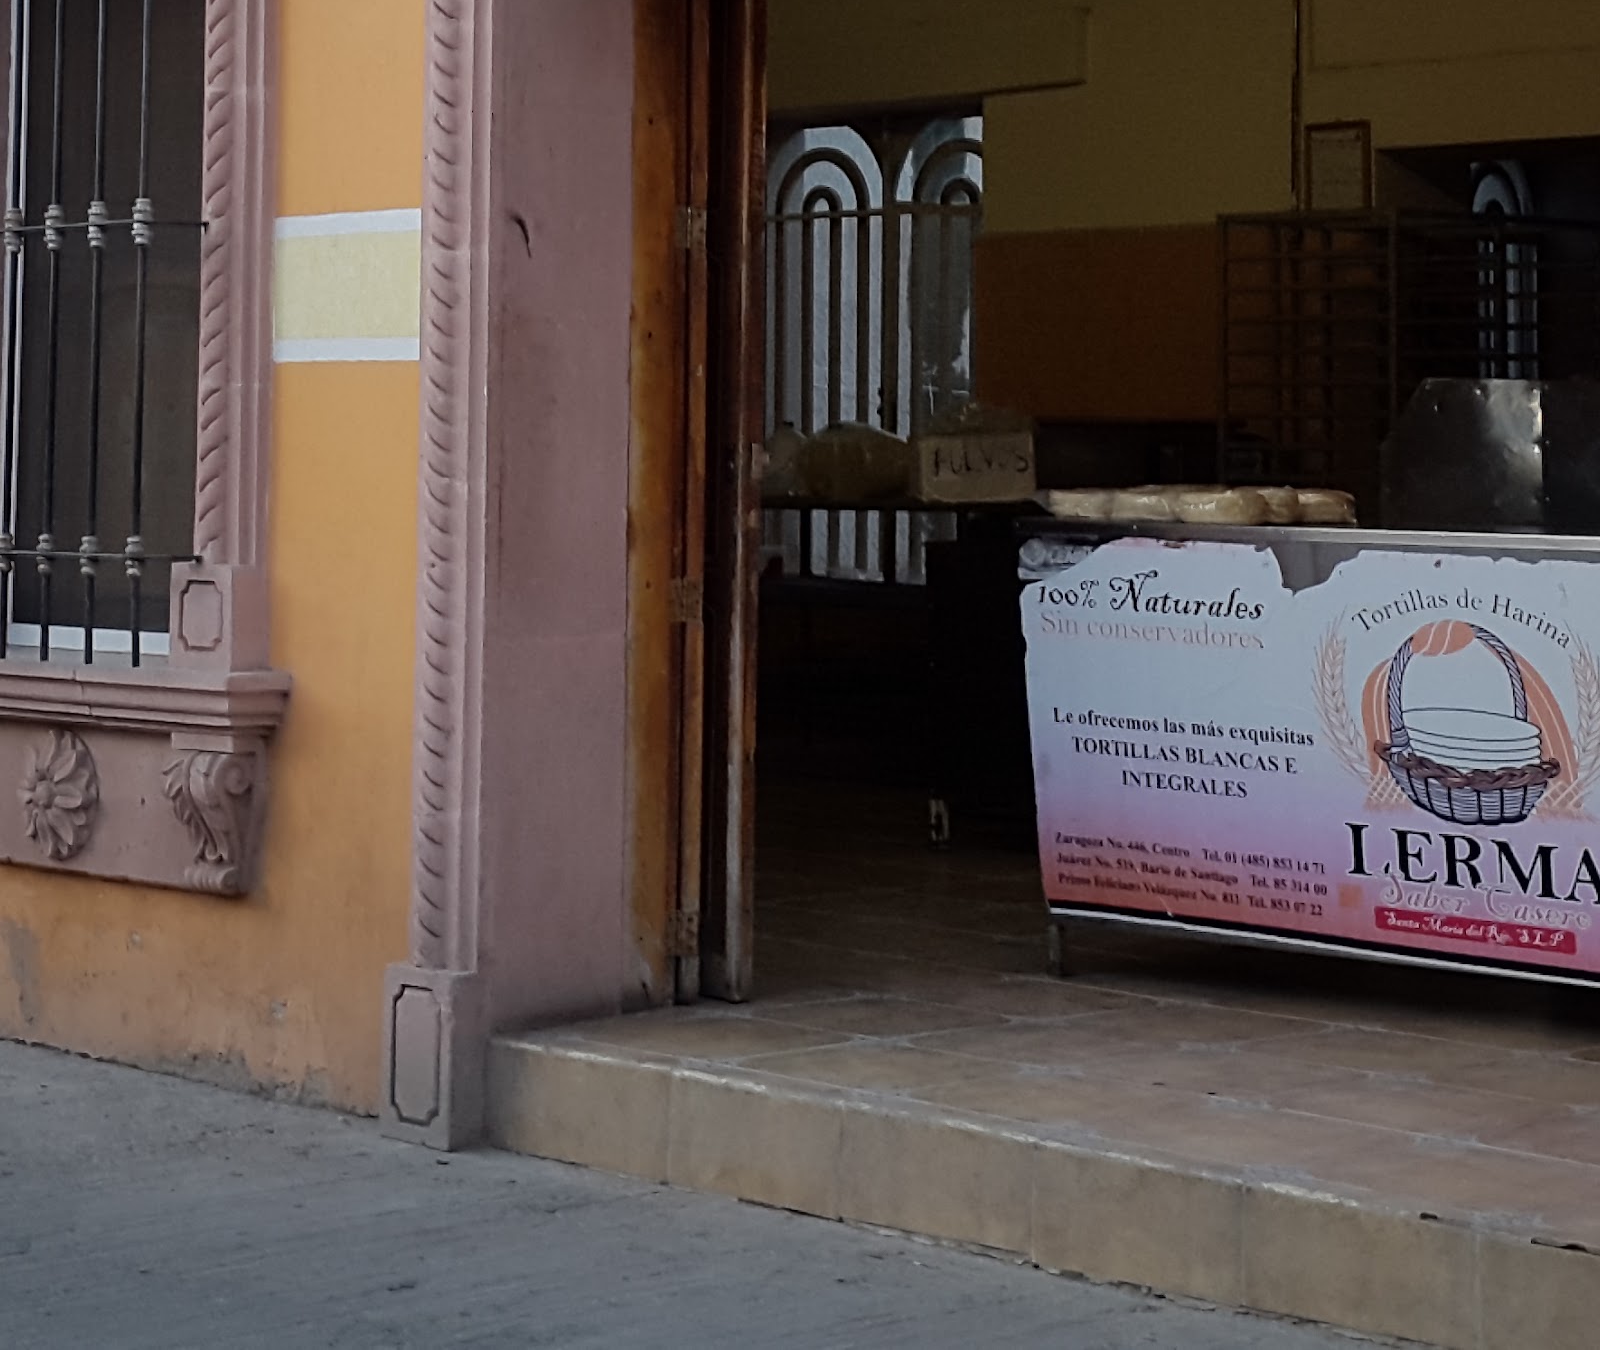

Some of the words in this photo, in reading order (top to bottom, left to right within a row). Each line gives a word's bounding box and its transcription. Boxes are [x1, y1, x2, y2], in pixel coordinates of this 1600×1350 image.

[1037, 578, 1100, 610] 100%
[1109, 569, 1265, 620] Naturales
[1041, 610, 1080, 635] Sin
[1087, 619, 1265, 649] conservadores
[1351, 588, 1449, 632] Tortillas
[1456, 587, 1483, 610] de
[1491, 593, 1571, 650] Harina
[1053, 707, 1075, 724] Le
[1078, 710, 1160, 733] ofrecemos
[1163, 717, 1187, 735] las
[1192, 719, 1225, 738] más
[1229, 726, 1315, 747] exquisitas
[1071, 735, 1180, 764] TORTILLAS
[1185, 746, 1279, 773] BLANCAS
[1285, 757, 1298, 775] E
[1121, 769, 1248, 799] INTEGRALES
[1152, 843, 1191, 857] Centro
